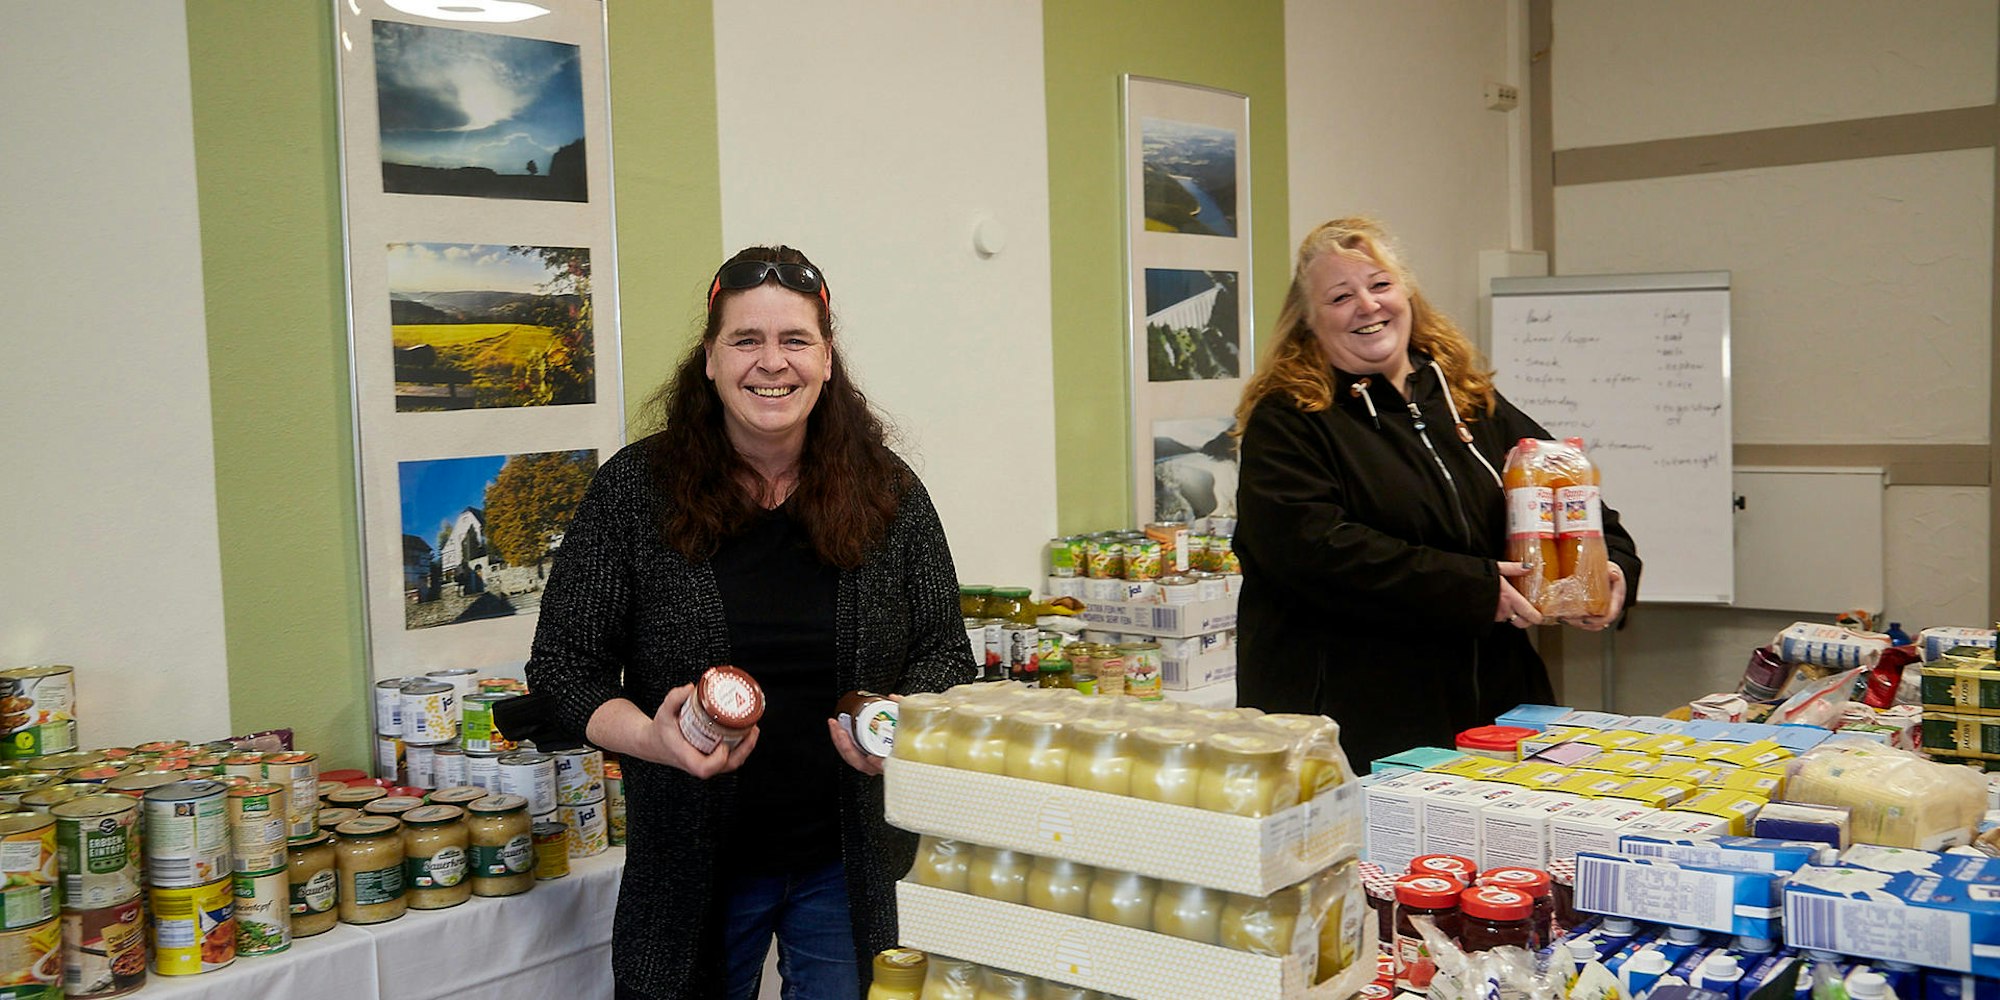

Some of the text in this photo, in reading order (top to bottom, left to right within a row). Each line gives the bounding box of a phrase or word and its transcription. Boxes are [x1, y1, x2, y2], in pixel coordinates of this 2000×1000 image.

[1129, 584, 1142, 598] ja!
[1204, 634, 1216, 648] ja!
[555, 759, 572, 775] ja!
[578, 807, 596, 826] ja!
